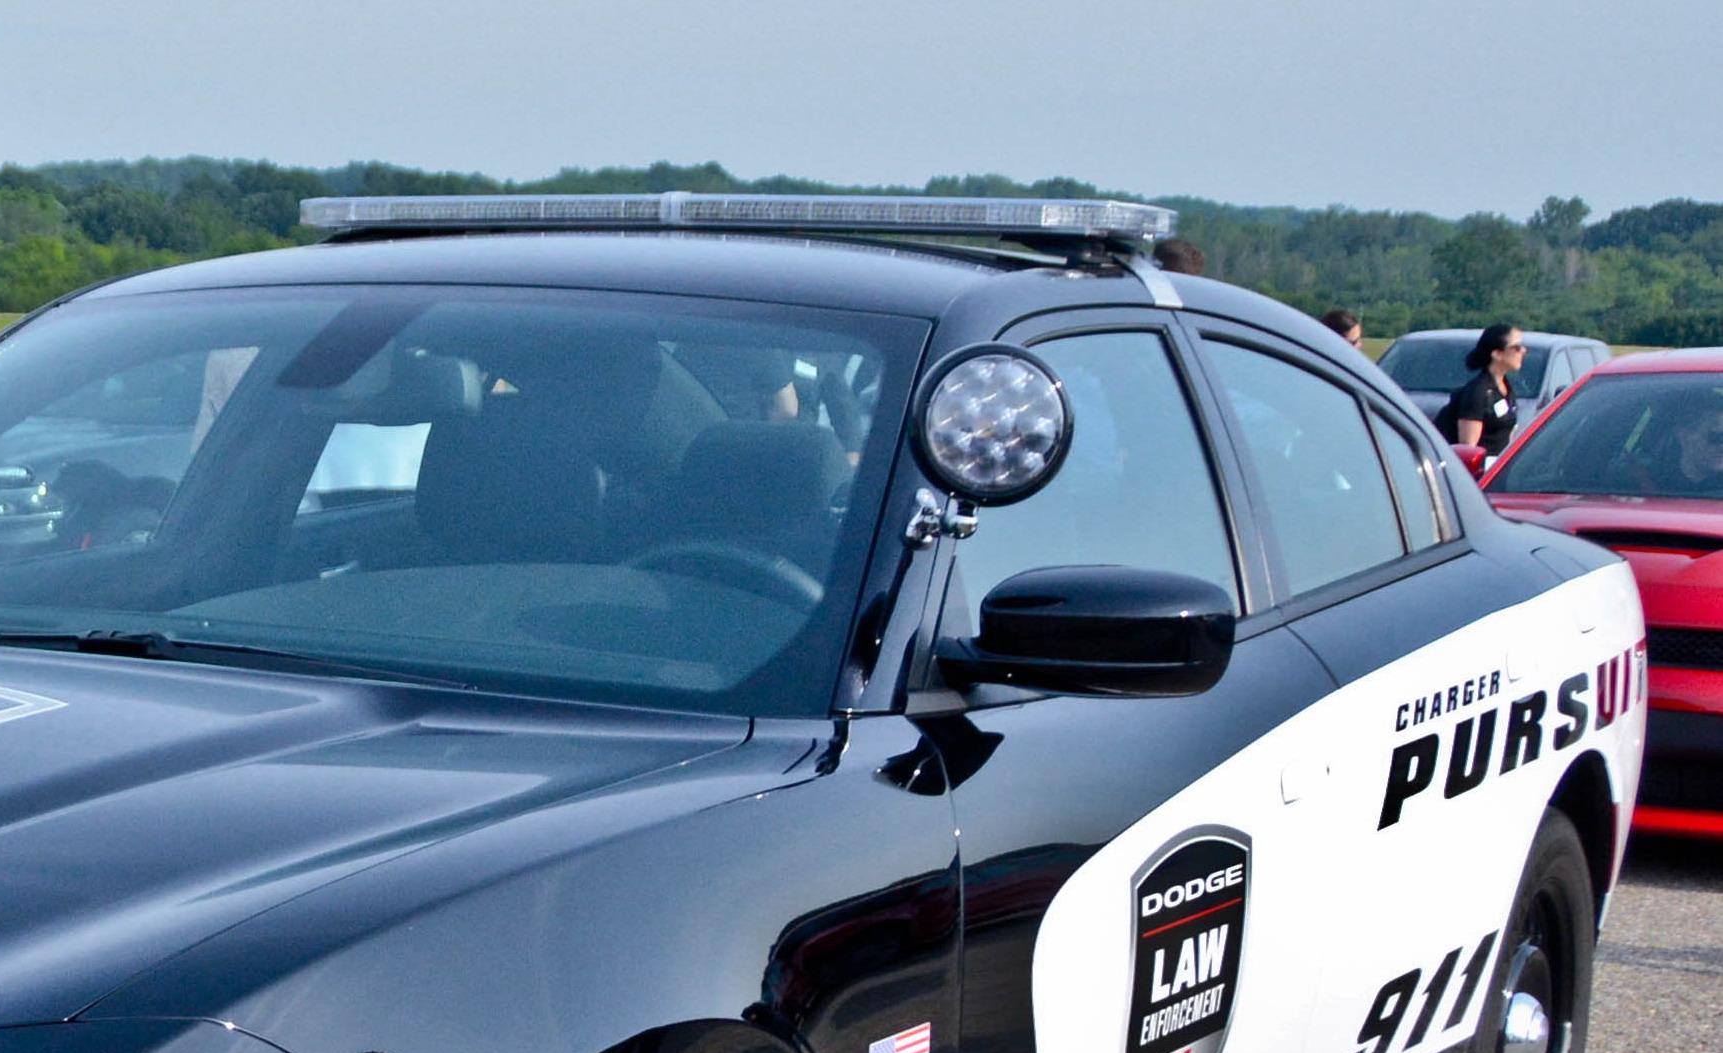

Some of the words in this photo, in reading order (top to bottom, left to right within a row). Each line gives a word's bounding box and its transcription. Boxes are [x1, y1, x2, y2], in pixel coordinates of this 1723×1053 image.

[1395, 670, 1501, 732] CHARGER
[1141, 863, 1244, 917] DODGE
[1151, 924, 1229, 1003] LAW
[1140, 983, 1226, 1046] ENFORCEMENT
